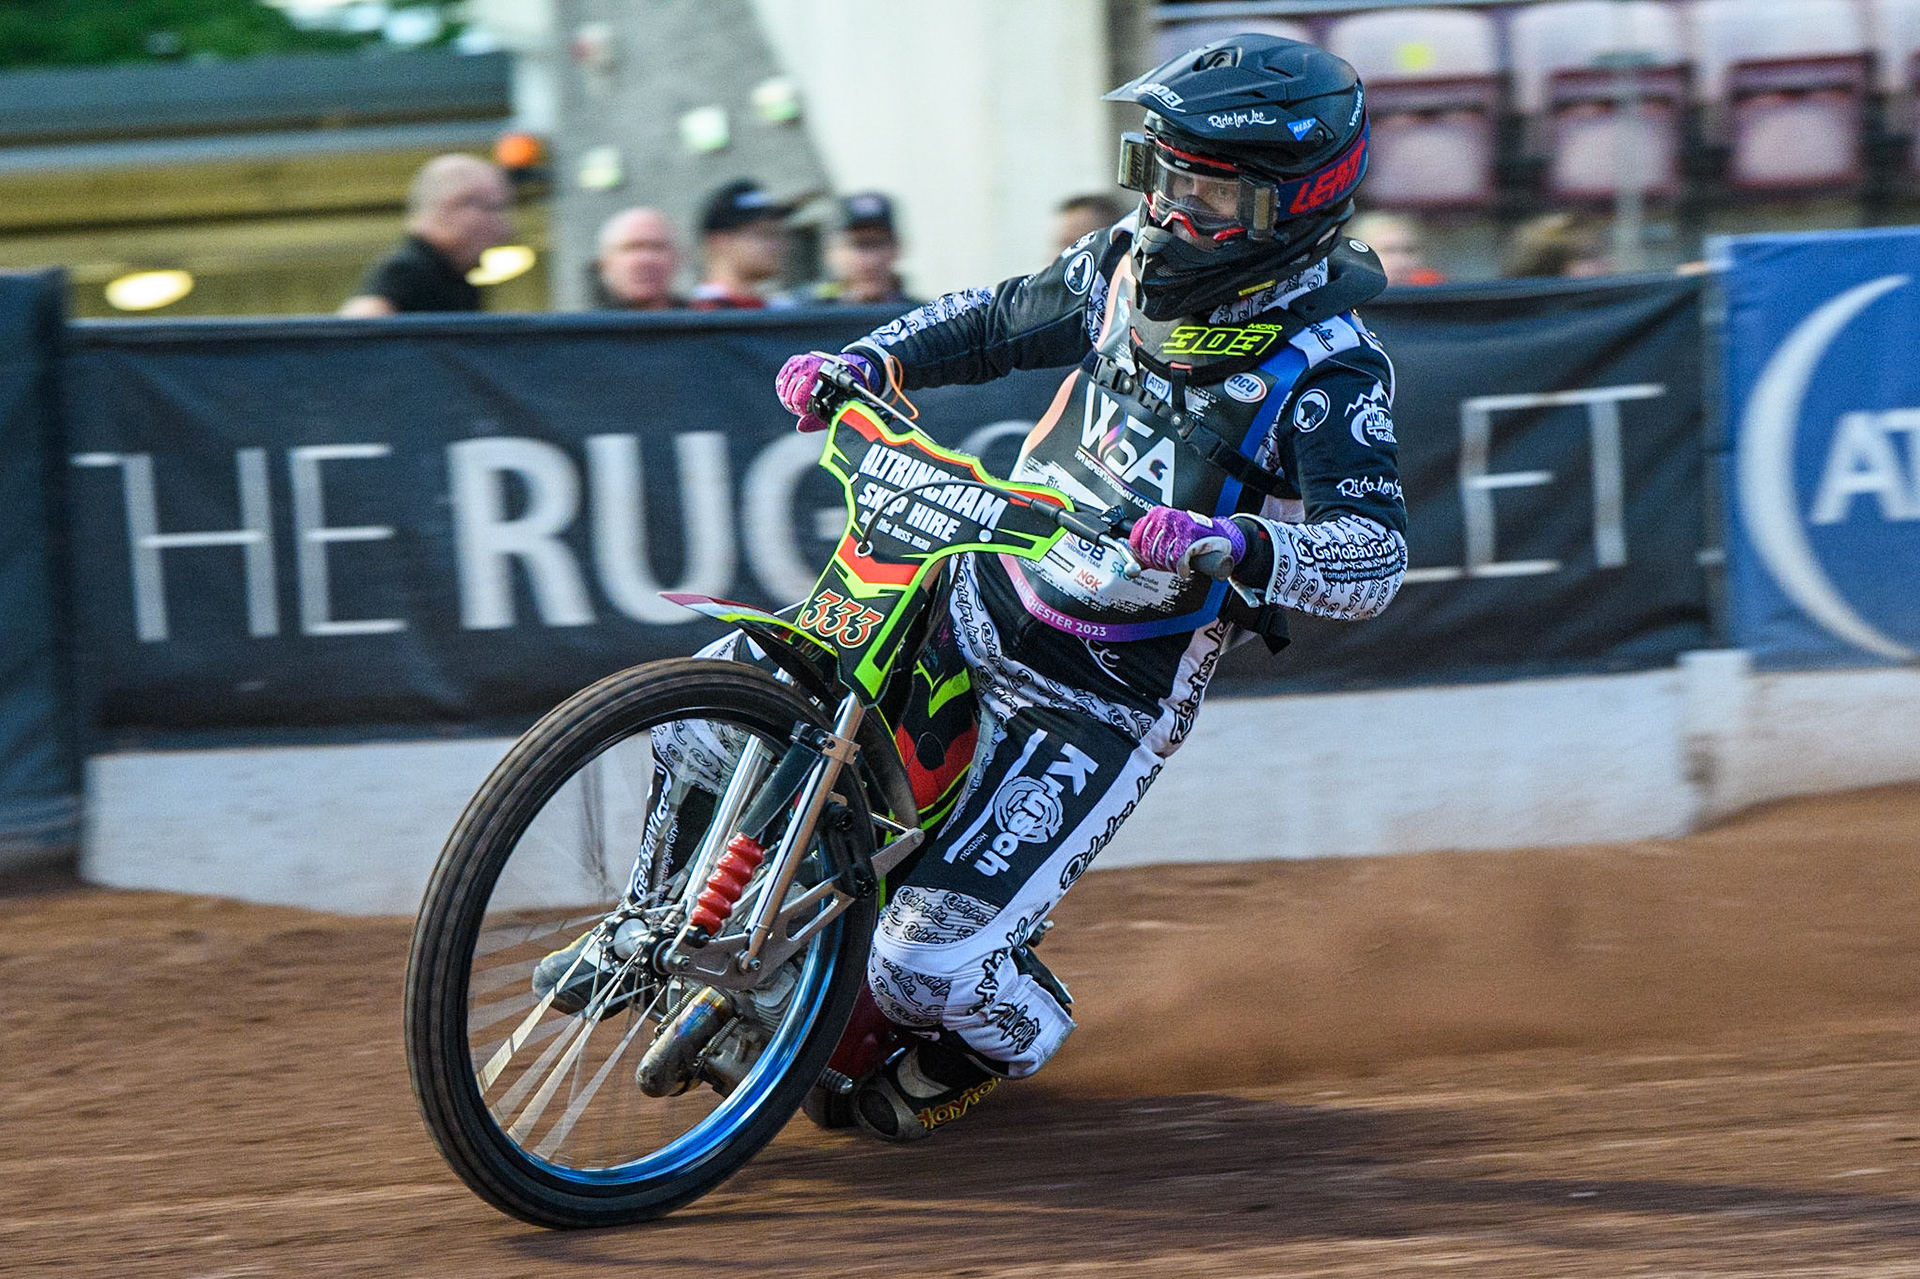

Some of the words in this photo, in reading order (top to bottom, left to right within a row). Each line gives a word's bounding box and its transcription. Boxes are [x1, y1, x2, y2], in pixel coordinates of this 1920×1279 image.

[1208, 114, 1233, 129] Ride
[1161, 325, 1278, 356] 303
[1247, 323, 1283, 332] MOTO
[1147, 376, 1167, 395] ATPI
[1229, 374, 1259, 393] ACU
[858, 443, 1009, 531] ALTRINGHAM
[856, 482, 909, 517] SKIP
[905, 502, 961, 543] HIRE
[1132, 495, 1154, 513] ACAD
[444, 428, 848, 632] RUG
[876, 517, 893, 534] the
[911, 535, 932, 552] man
[1063, 541, 1088, 560] SPEEDWAY
[1086, 555, 1102, 569] TEAM
[1078, 539, 1106, 561] GB
[1076, 569, 1103, 592] NGK
[799, 587, 885, 649] 333
[1013, 576, 1072, 629] MANCHESTER
[1075, 622, 1107, 637] 2023
[959, 832, 989, 862] Holzbau
[916, 1076, 1002, 1131] dayto
